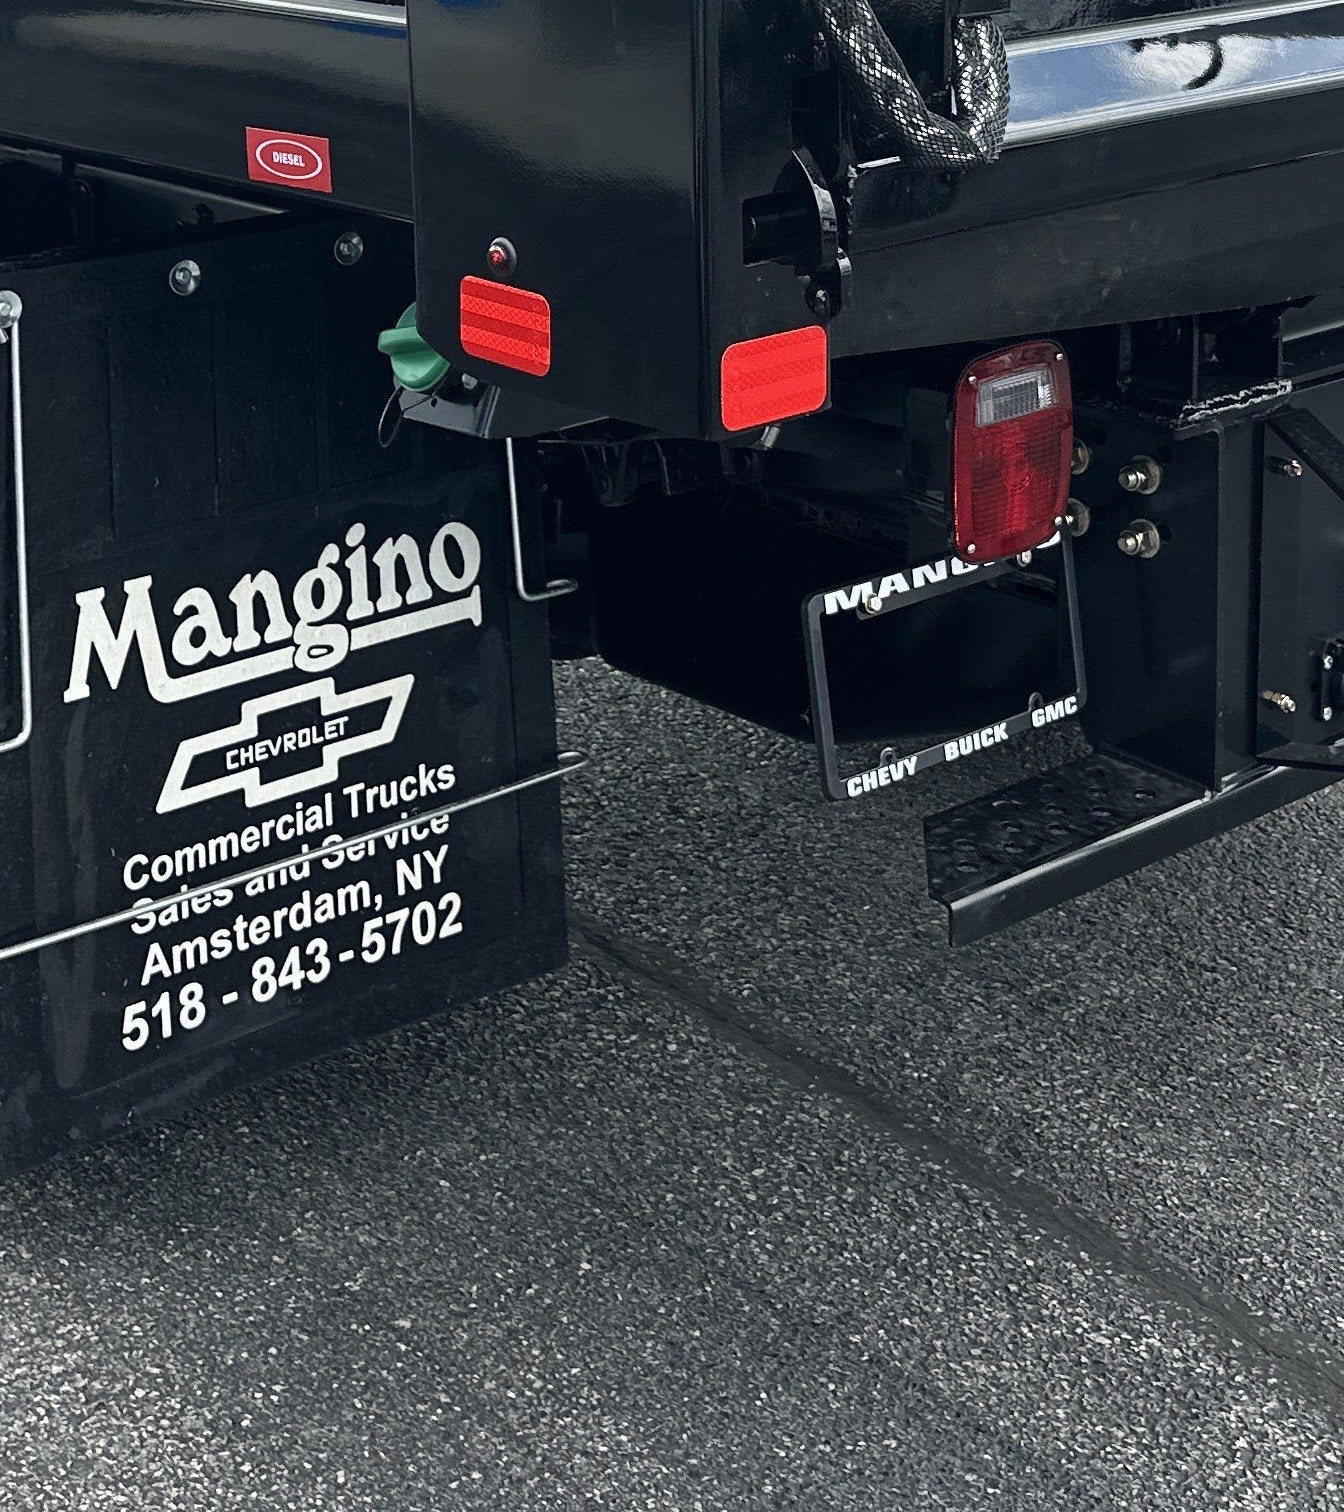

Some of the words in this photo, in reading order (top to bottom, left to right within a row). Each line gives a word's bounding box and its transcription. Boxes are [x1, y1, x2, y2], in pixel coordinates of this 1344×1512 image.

[272, 151, 305, 167] DIESEL
[63, 521, 483, 704] Mangino
[225, 715, 349, 771] CHEVROLET
[846, 755, 918, 799] CHEVY
[943, 722, 1009, 763] BUICK
[1031, 695, 1078, 729] GMC
[122, 792, 333, 890] Commercial
[342, 761, 457, 819] Trucks
[130, 884, 234, 935] Sales
[244, 844, 312, 897] and
[140, 879, 383, 986] Amsterdam,
[396, 844, 450, 896] NY
[121, 982, 206, 1052] 518
[251, 937, 332, 1003] 843
[361, 891, 464, 964] 5702
